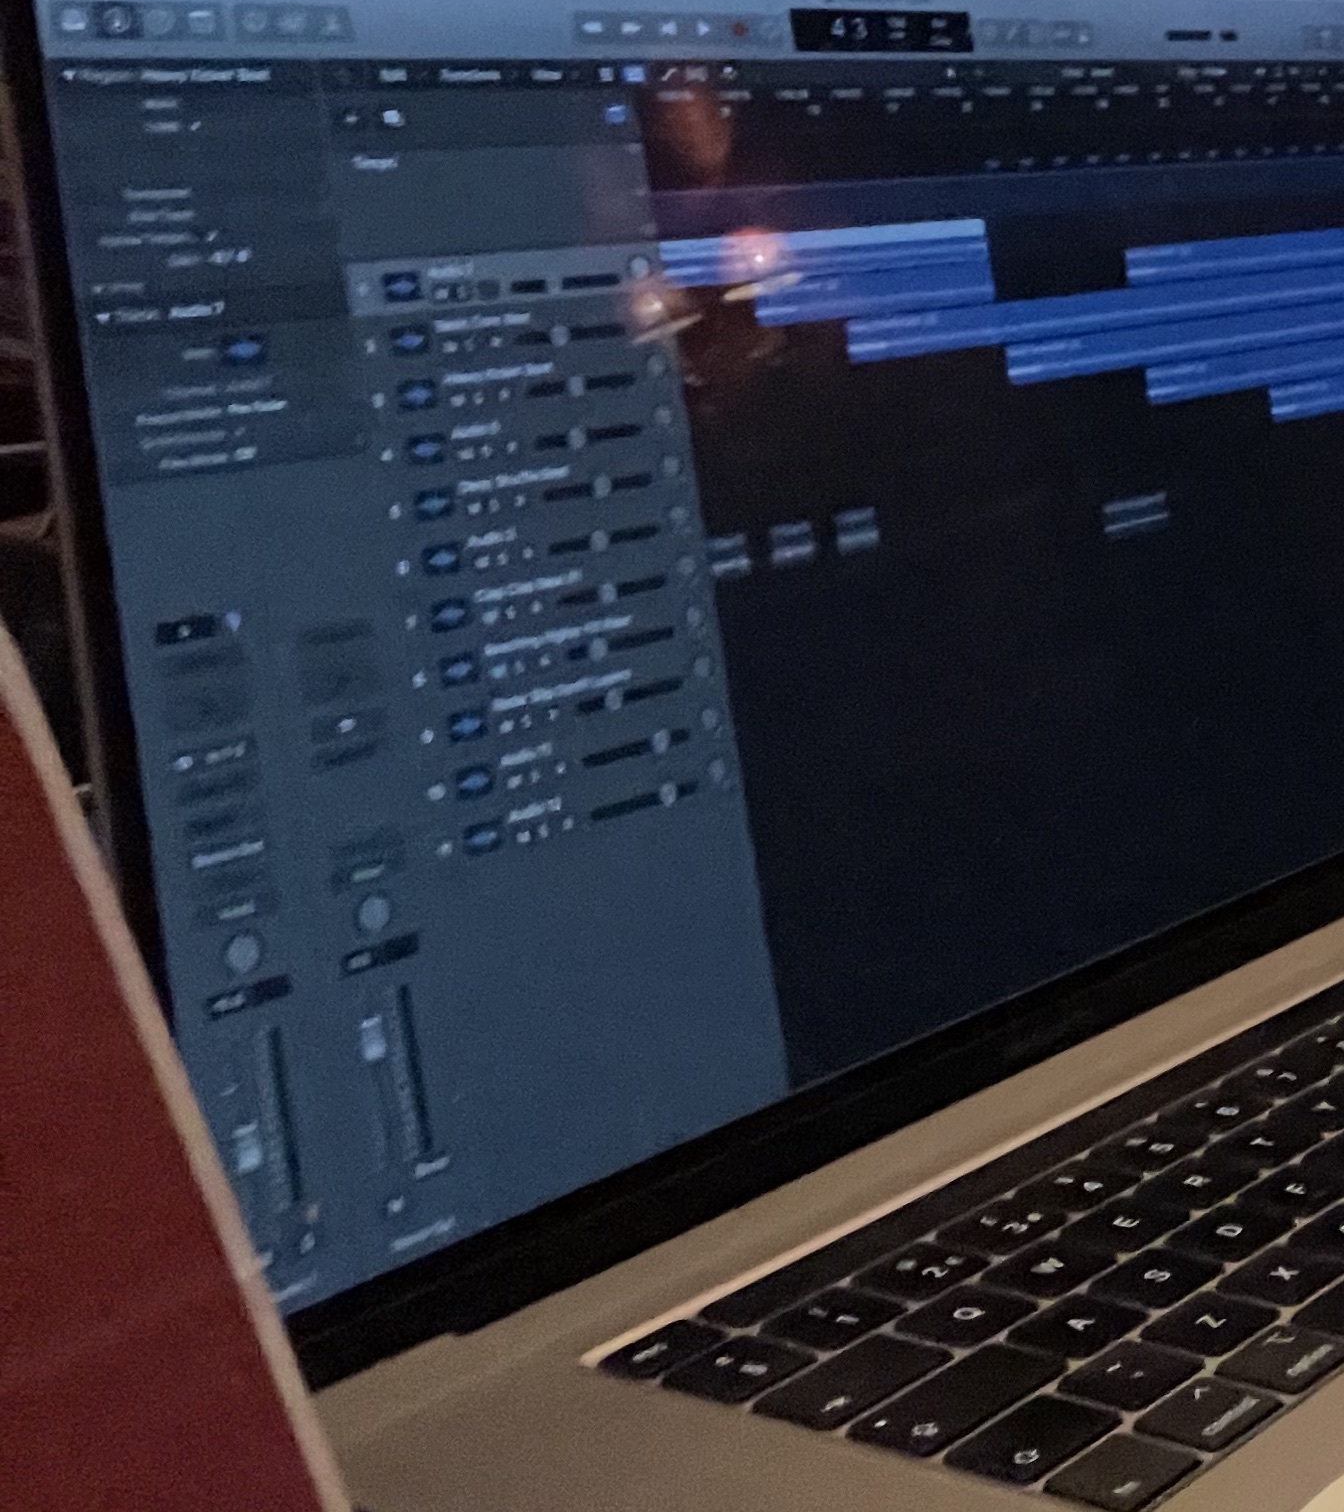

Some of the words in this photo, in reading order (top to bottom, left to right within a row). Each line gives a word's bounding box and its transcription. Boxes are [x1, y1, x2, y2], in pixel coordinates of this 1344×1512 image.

[953, 1307, 986, 1320] Q
[1112, 1216, 1140, 1228] E
[1067, 1318, 1095, 1331] A
[1143, 1268, 1171, 1282] S
[1215, 1224, 1243, 1238] D
[1195, 1314, 1227, 1329] Z
[1270, 1266, 1299, 1281] X
